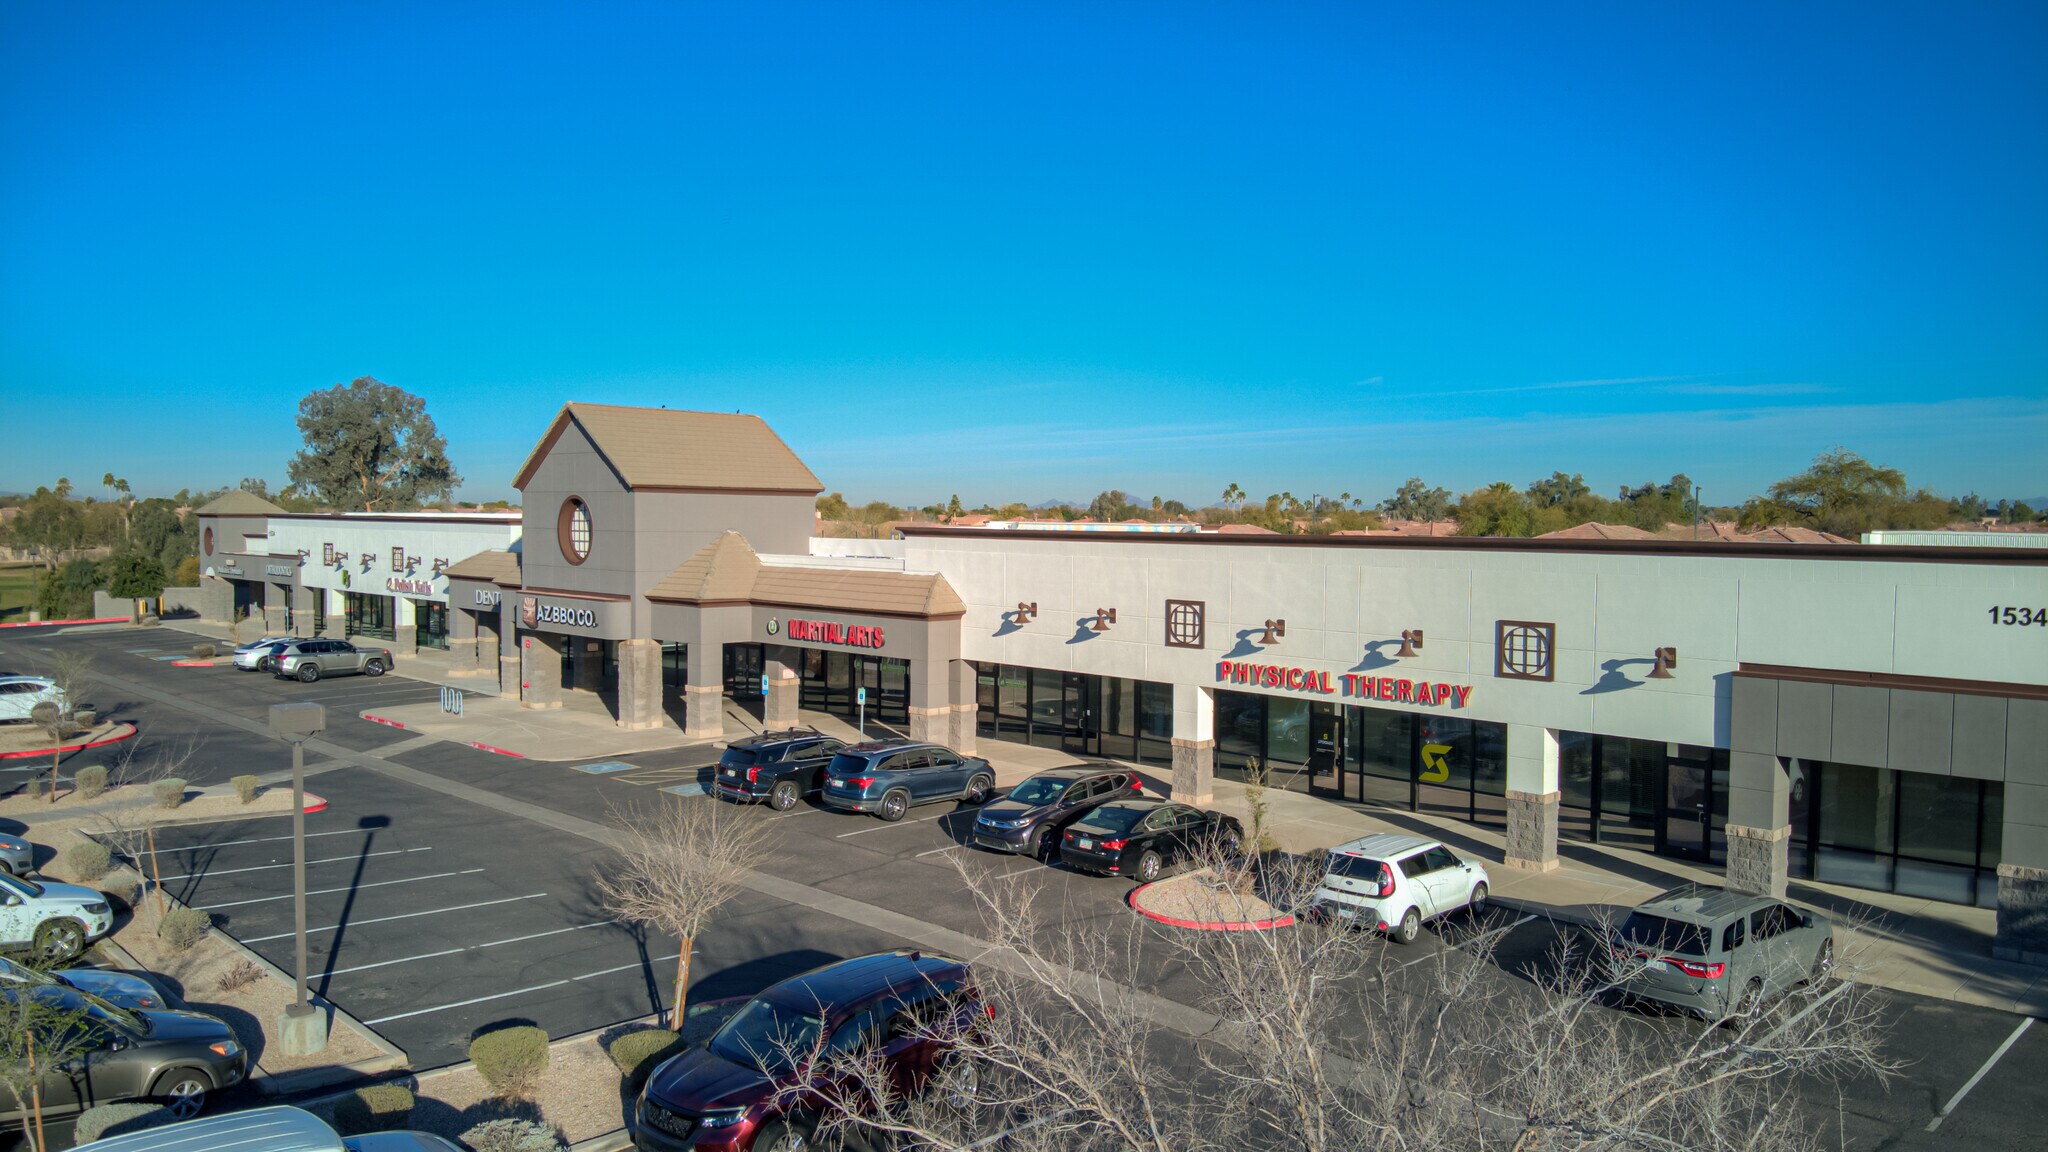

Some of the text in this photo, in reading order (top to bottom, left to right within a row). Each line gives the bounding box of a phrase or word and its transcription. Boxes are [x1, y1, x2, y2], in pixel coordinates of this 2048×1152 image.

[1988, 605, 2048, 627] 1534
[788, 618, 884, 649] MARTIAL ARTS
[1219, 660, 1472, 708] PHYSICAL THERAPY
